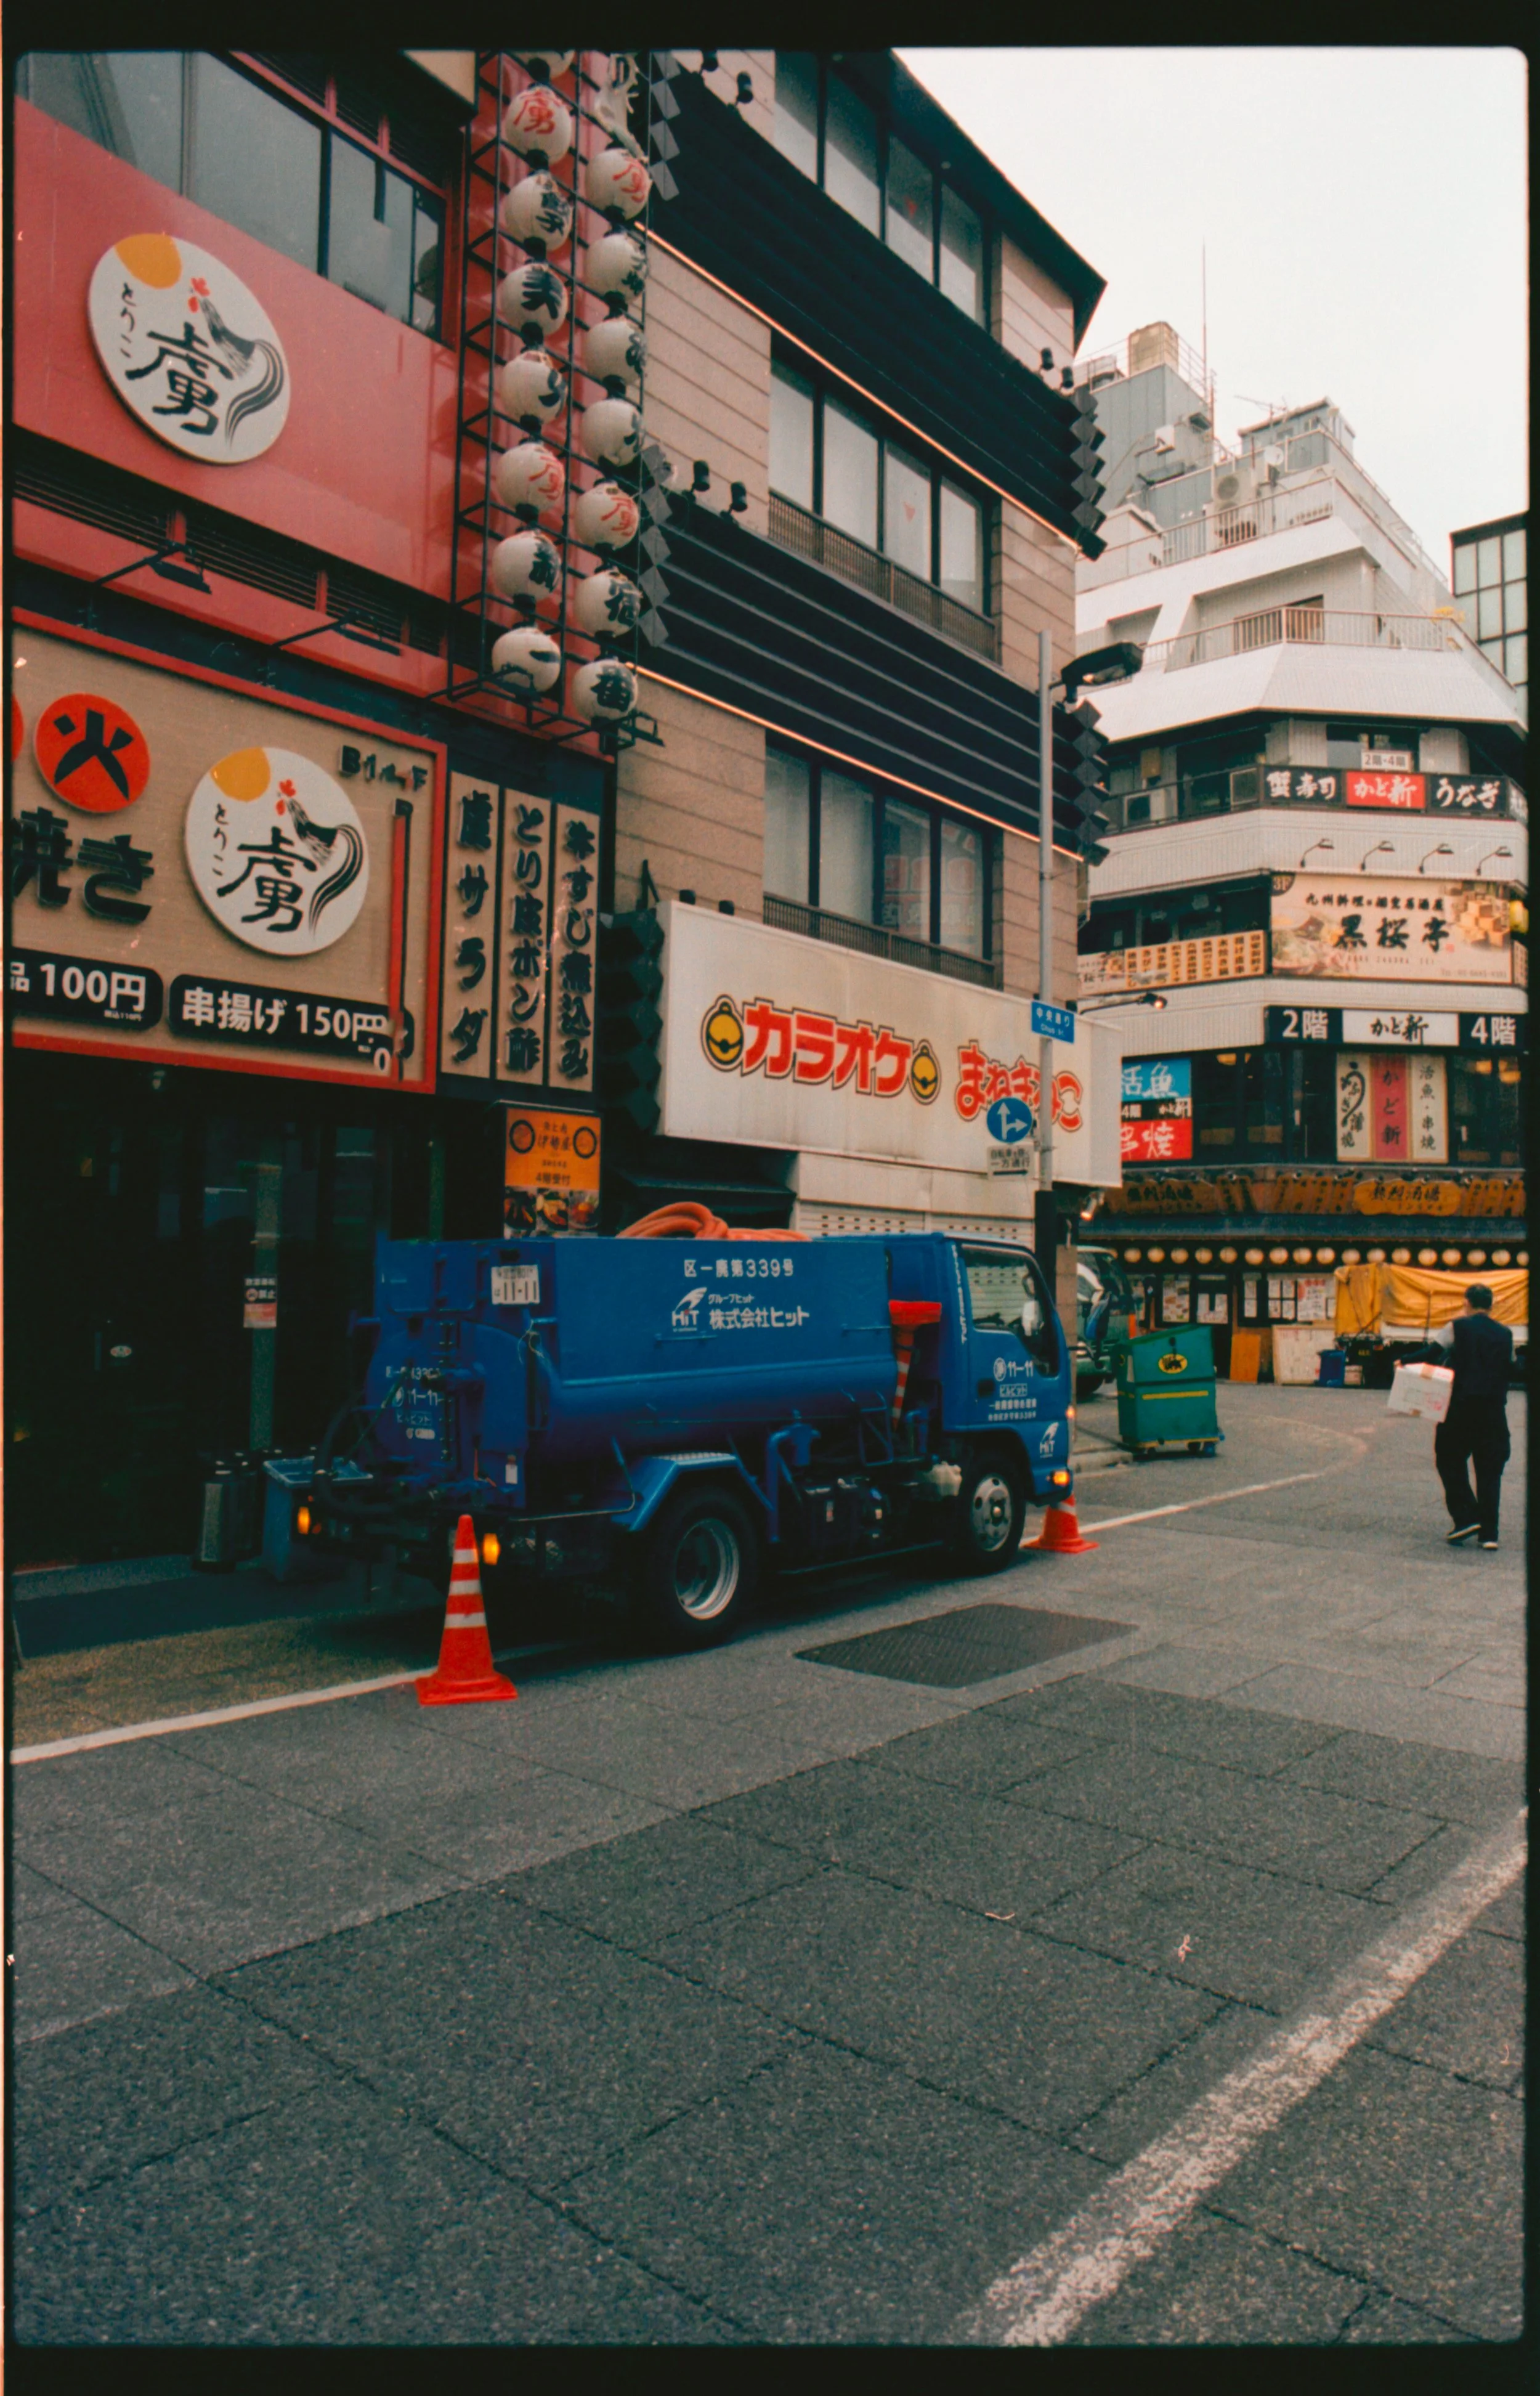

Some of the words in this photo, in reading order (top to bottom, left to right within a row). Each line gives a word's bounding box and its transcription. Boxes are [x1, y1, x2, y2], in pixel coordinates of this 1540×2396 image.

[53, 709, 134, 800] 火
[1355, 776, 1417, 807] かど新
[1437, 778, 1501, 809] うなぎ
[506, 804, 544, 1071] とり皮ポン酢
[557, 820, 596, 1078] 牛すじ煮込み
[40, 964, 146, 1012] 100円
[182, 988, 286, 1034] 串揚げ
[296, 1004, 389, 1043] 150円
[1283, 1009, 1327, 1039] 2階
[1370, 1015, 1429, 1042] かど新
[1471, 1017, 1517, 1046] 4階
[743, 1003, 912, 1093] カラオケ
[1383, 1070, 1401, 1145] かど新
[709, 1306, 810, 1330] 株式会社ヒット
